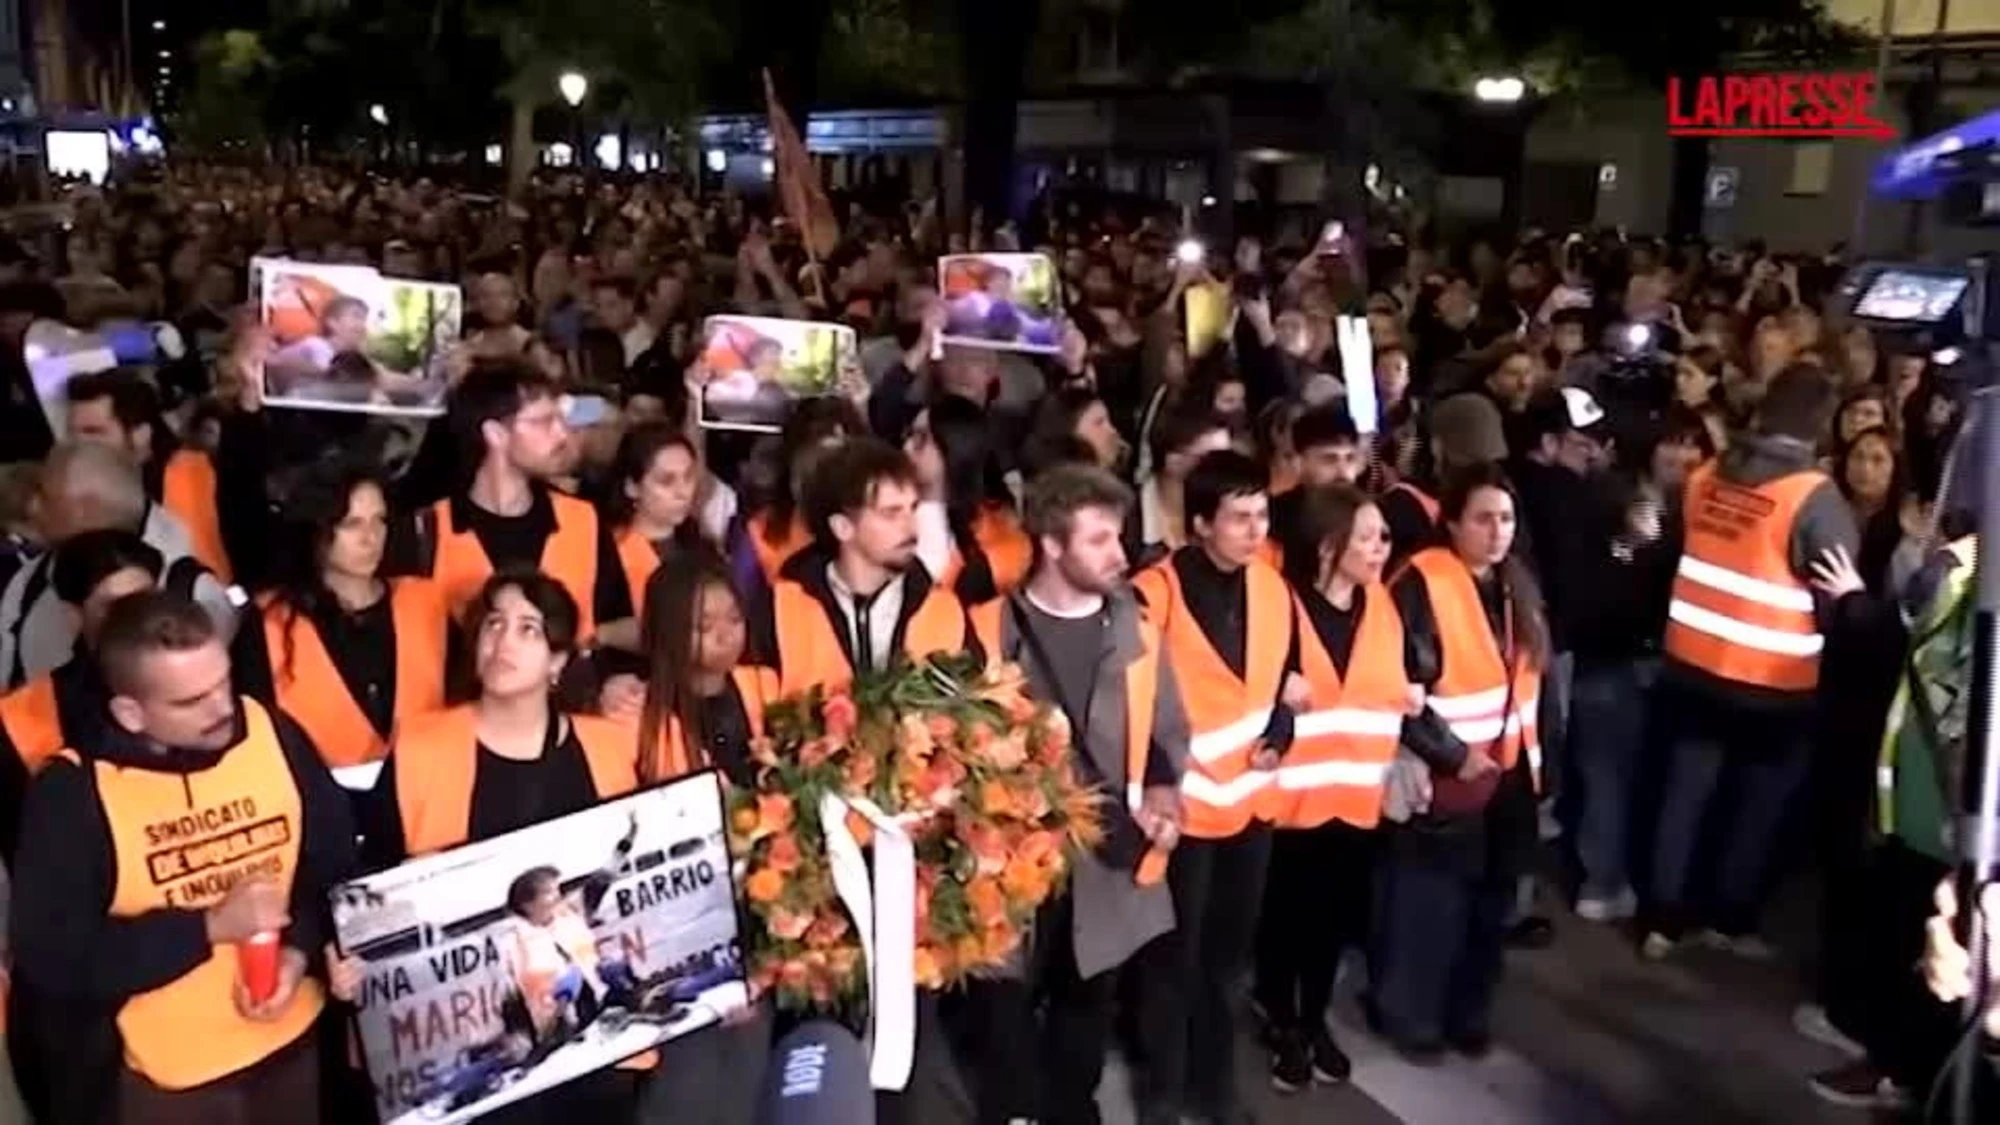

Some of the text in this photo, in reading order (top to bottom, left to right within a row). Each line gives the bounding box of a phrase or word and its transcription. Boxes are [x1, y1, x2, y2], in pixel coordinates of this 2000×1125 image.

[144, 797, 257, 845] SINDICATO
[615, 860, 715, 918] BARRIO
[430, 935, 500, 983] VIDA
